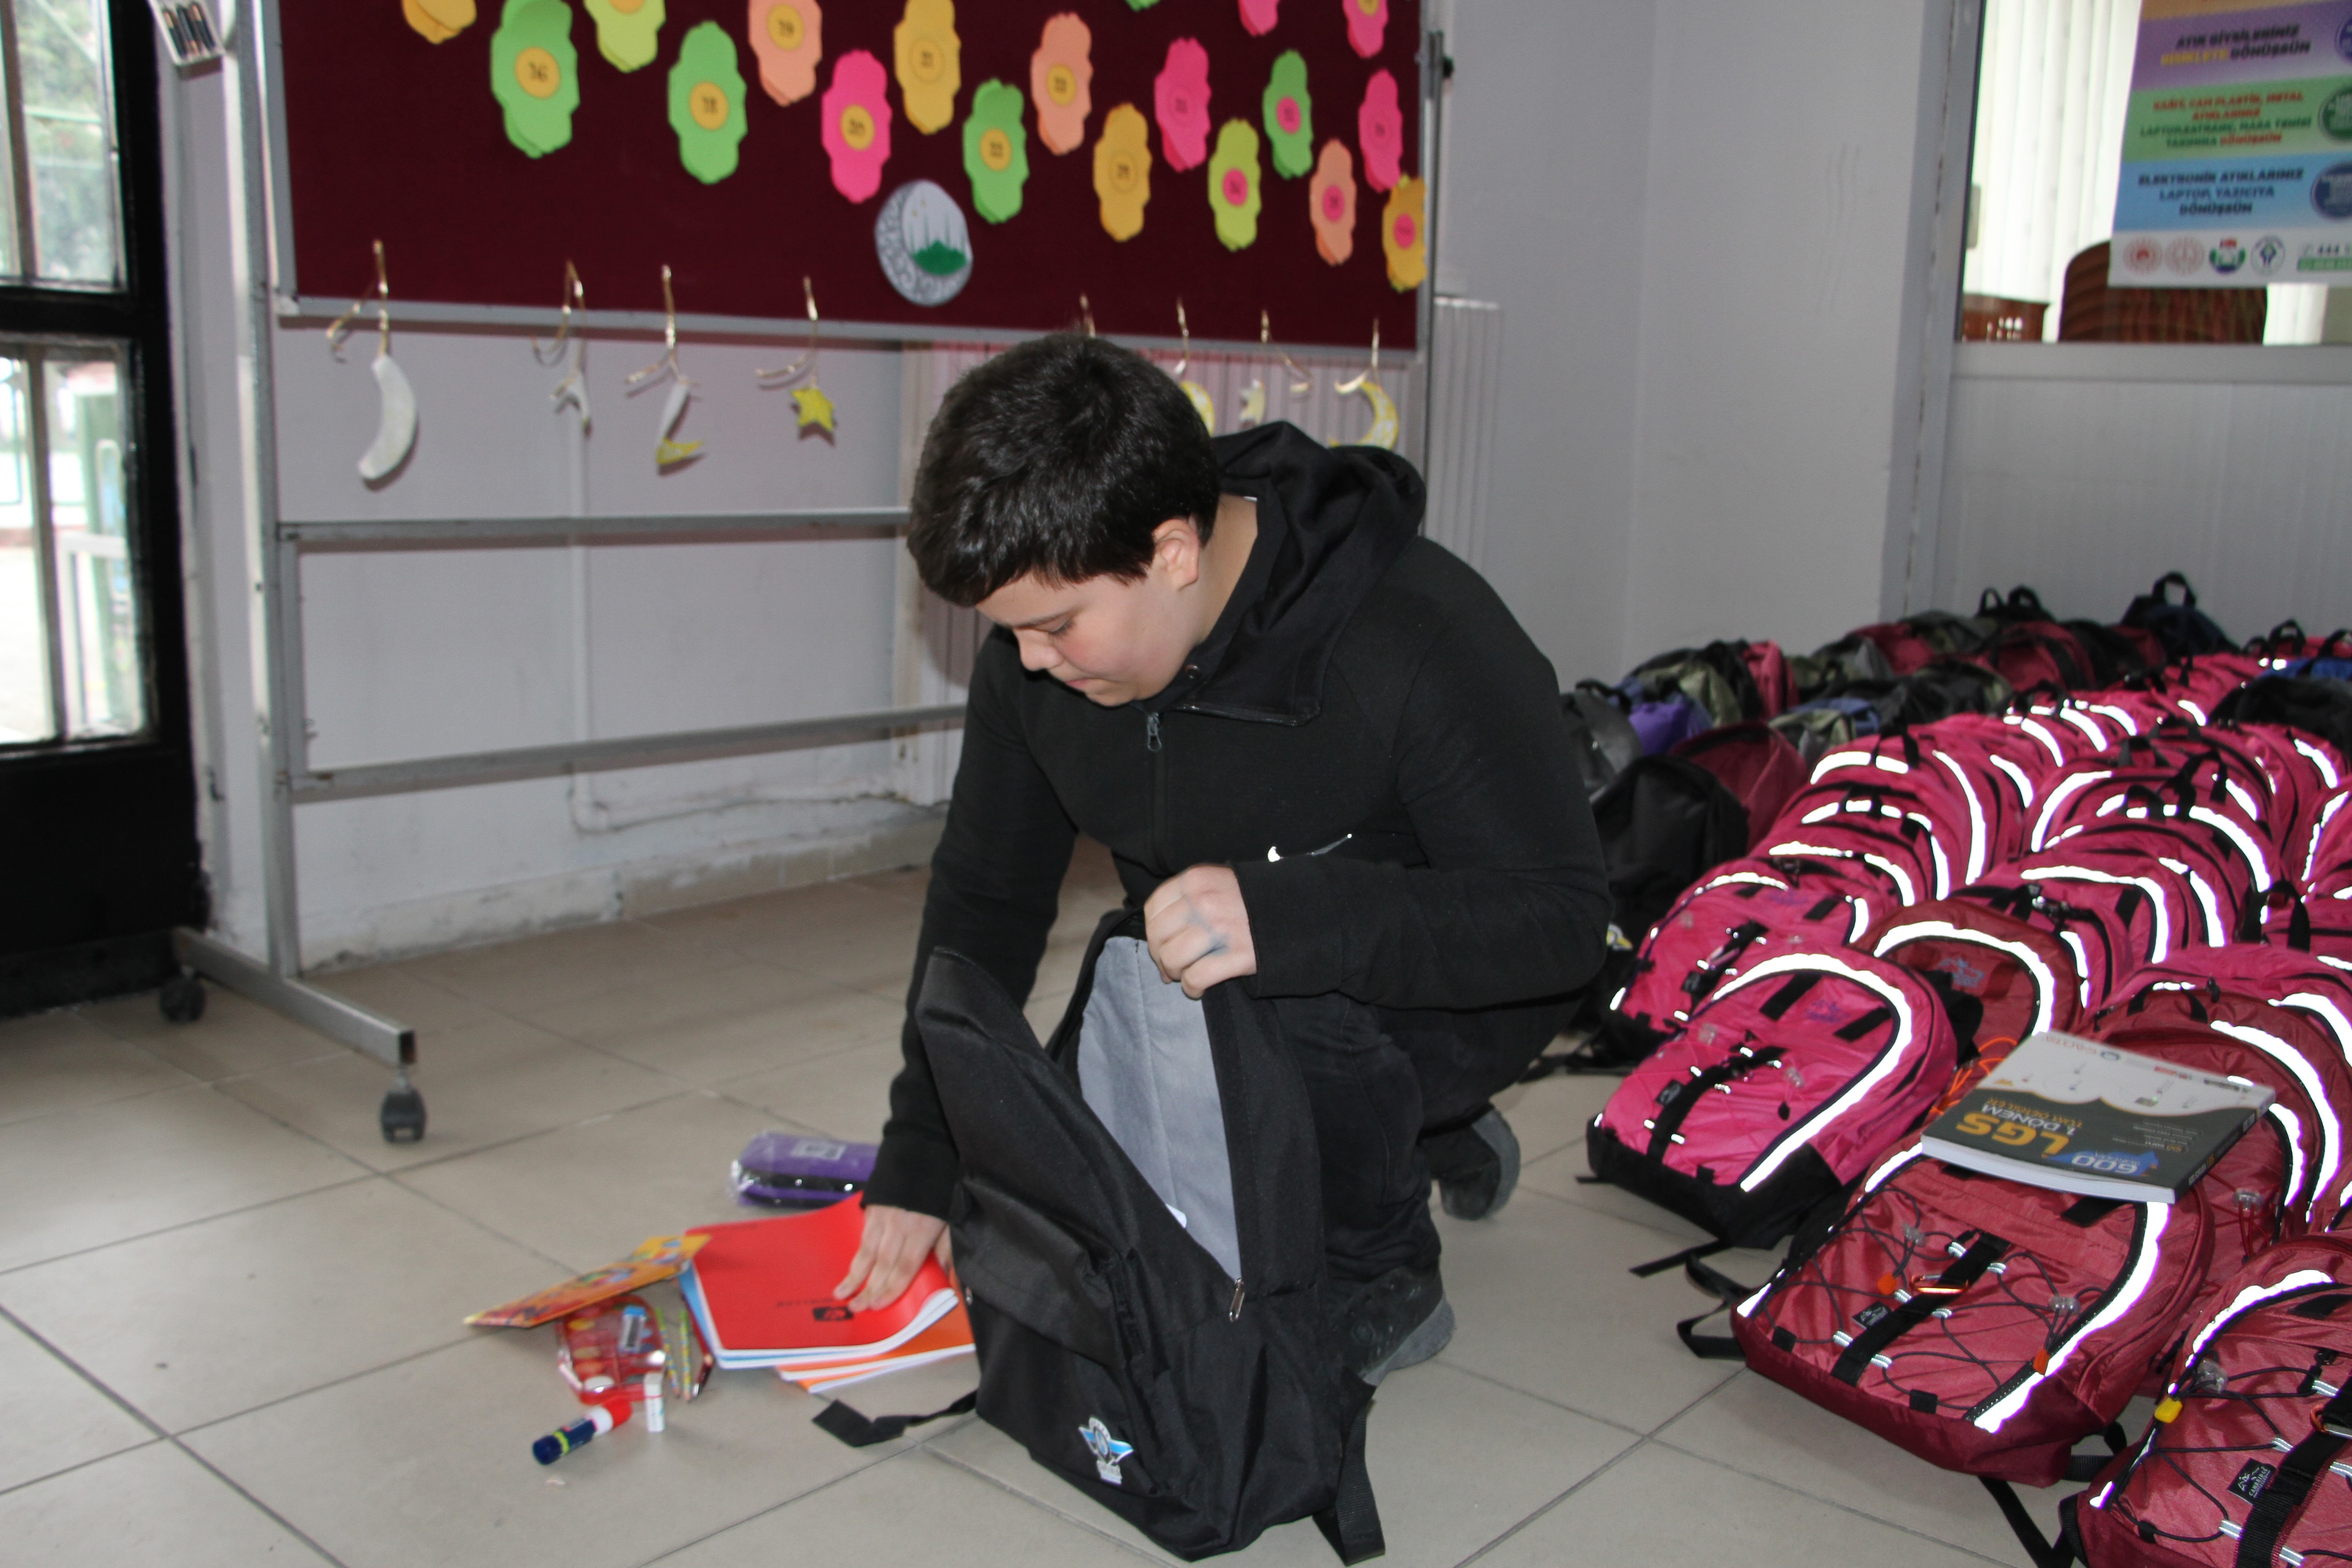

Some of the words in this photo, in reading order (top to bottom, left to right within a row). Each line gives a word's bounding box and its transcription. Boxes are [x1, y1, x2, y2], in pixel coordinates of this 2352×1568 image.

[1981, 1103, 2061, 1132] DÖNEM
[1956, 1112, 2070, 1156] LGS
[2071, 1155, 2138, 1174] 600
[2249, 1466, 2268, 1496] CAMBRIDGE
